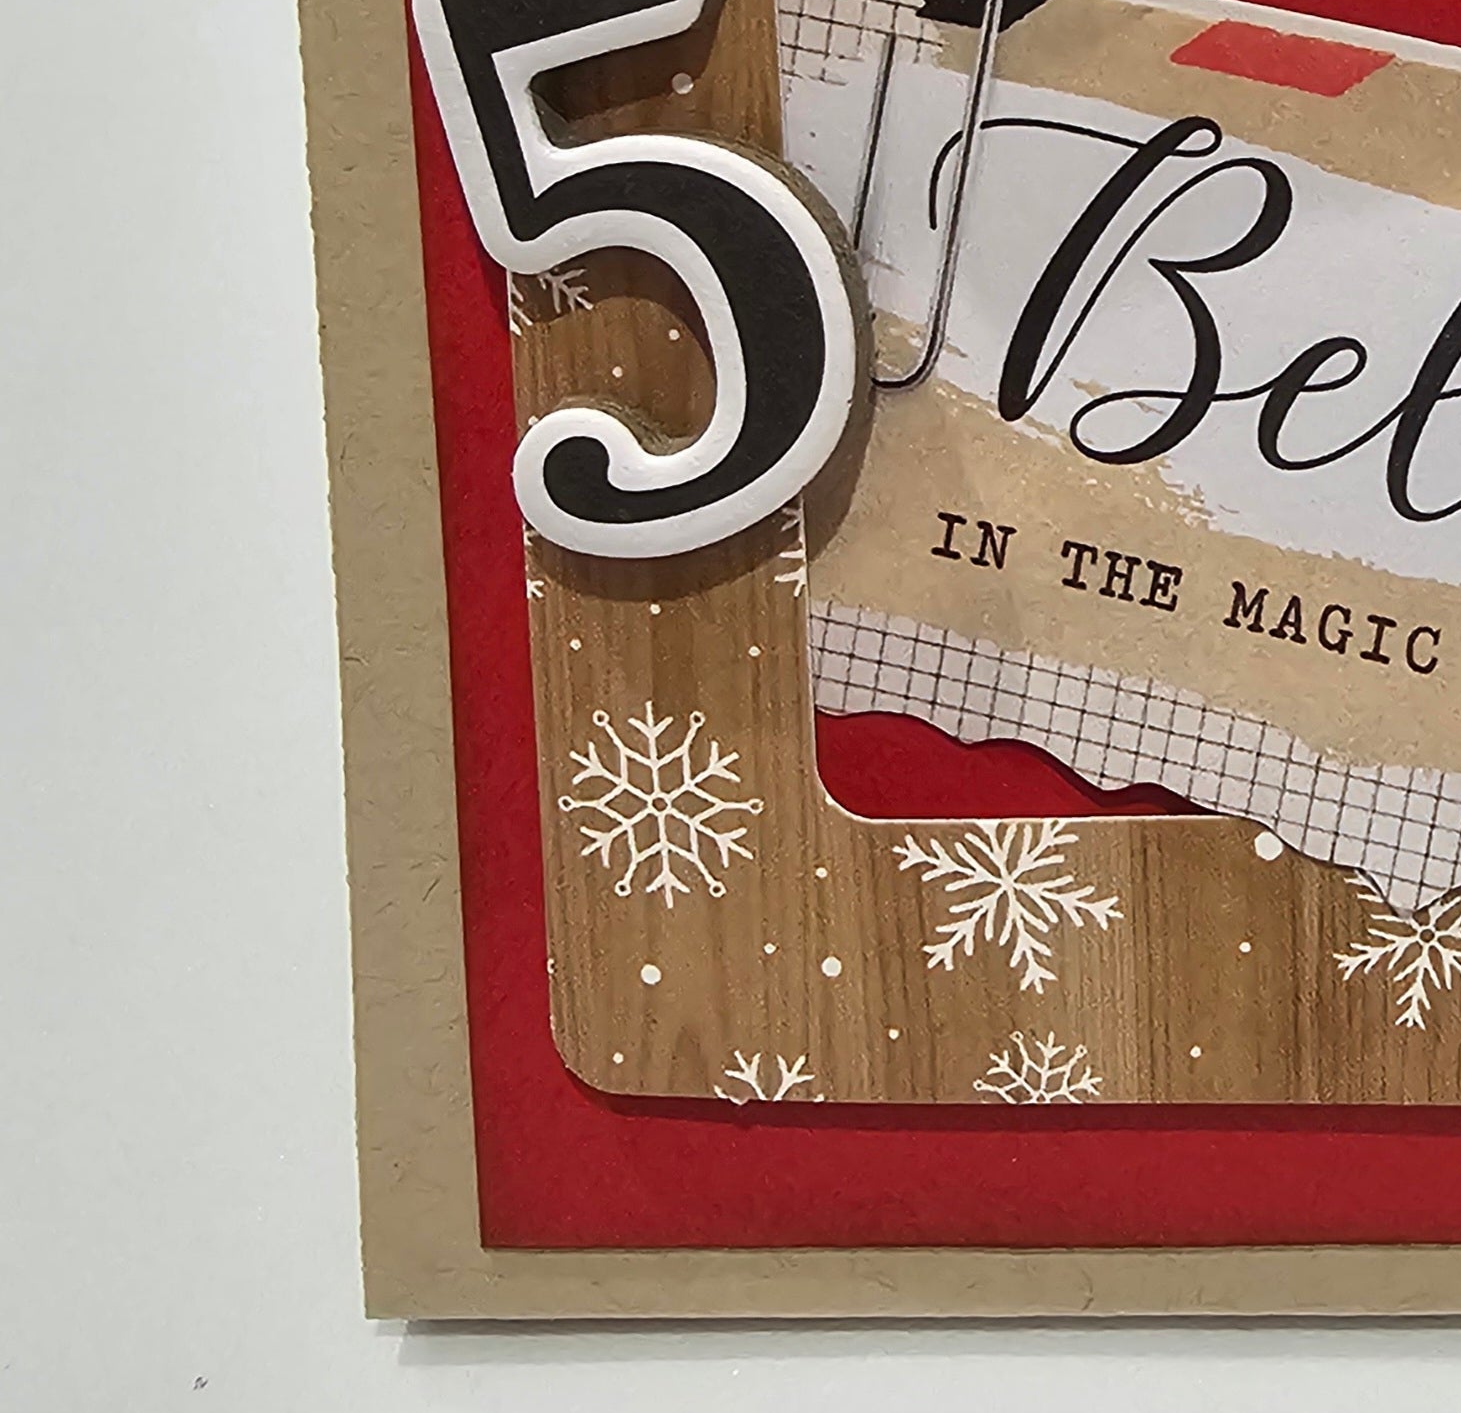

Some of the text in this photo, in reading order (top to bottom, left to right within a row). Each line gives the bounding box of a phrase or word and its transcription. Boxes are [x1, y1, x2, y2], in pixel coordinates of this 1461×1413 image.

[930, 511, 1017, 571] IN
[1060, 539, 1184, 613] THE
[1222, 580, 1442, 675] MAGIC
